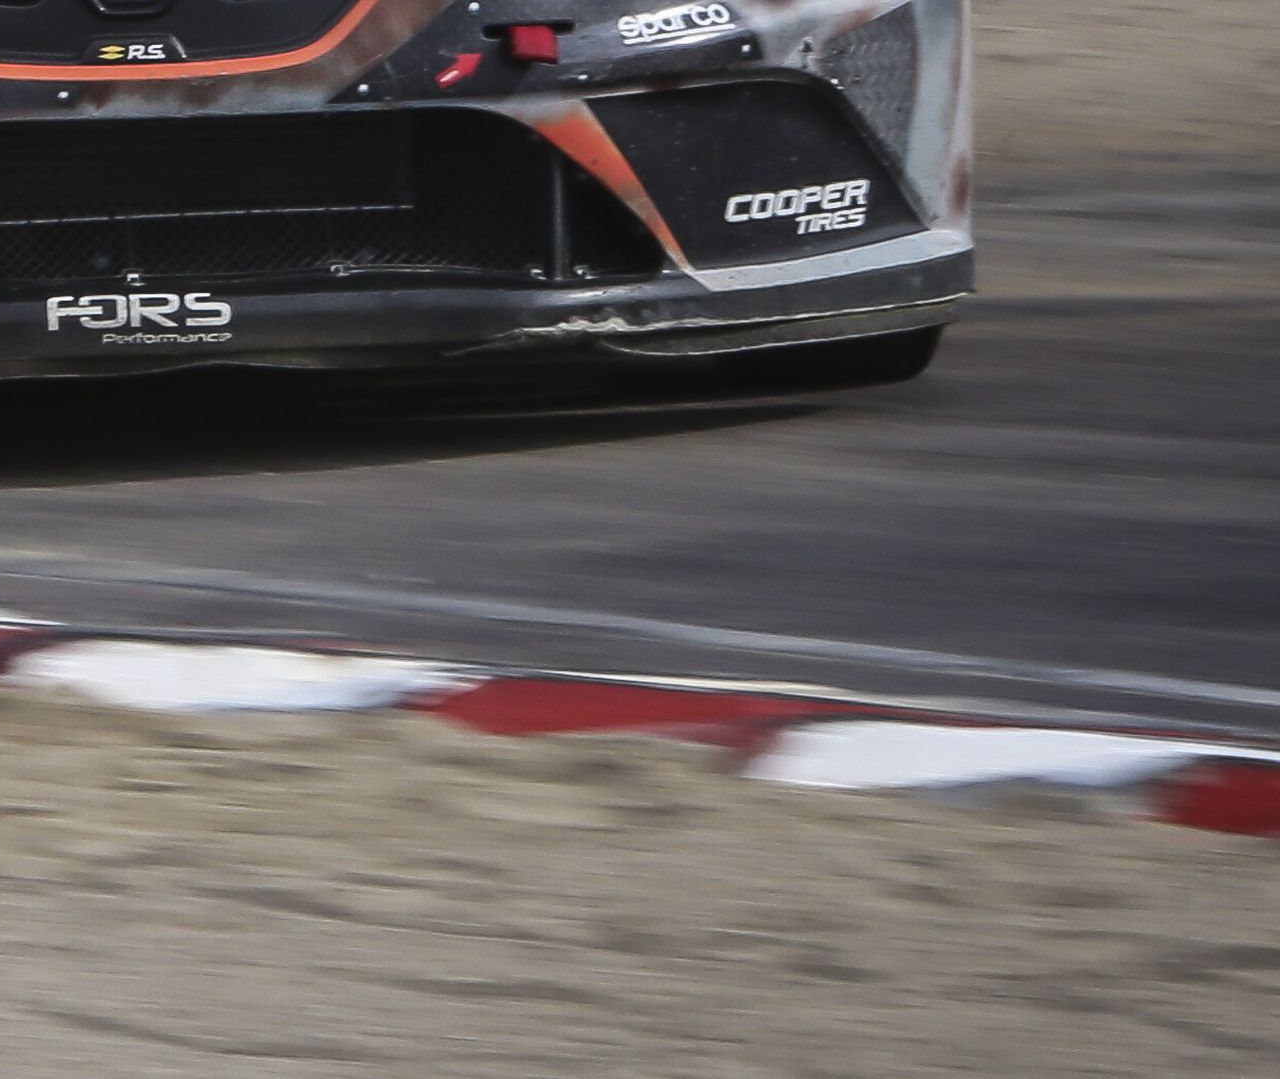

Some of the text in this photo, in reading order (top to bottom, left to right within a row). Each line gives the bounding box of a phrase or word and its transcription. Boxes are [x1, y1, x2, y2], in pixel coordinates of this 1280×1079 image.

[617, 2, 733, 40] sparco
[724, 178, 872, 224] COOPER
[796, 207, 867, 236] TIRES
[46, 292, 233, 331] FORS
